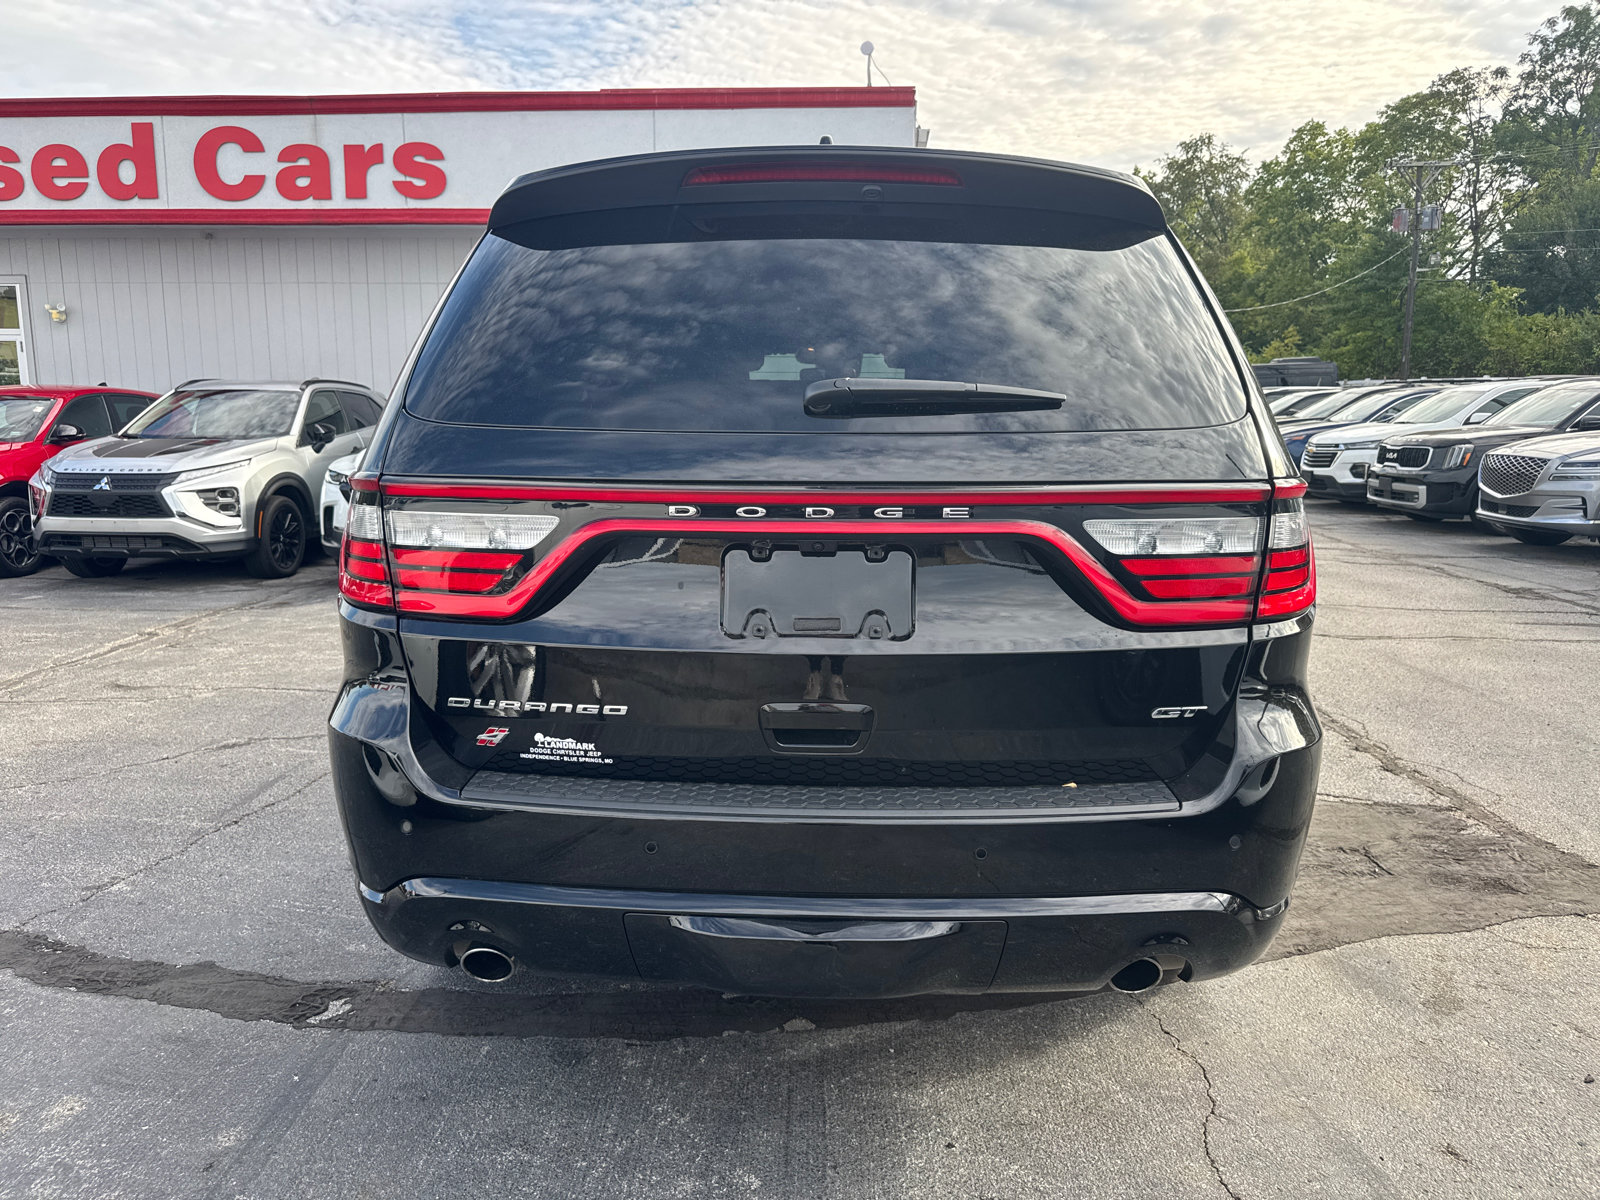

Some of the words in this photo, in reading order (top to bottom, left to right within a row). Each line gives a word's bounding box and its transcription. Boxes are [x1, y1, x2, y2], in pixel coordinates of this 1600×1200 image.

[194, 125, 447, 200] Cars
[668, 505, 971, 518] DODGE
[447, 697, 629, 716] DURANGO
[1151, 705, 1208, 719] GT
[544, 740, 596, 751] LANDMARK
